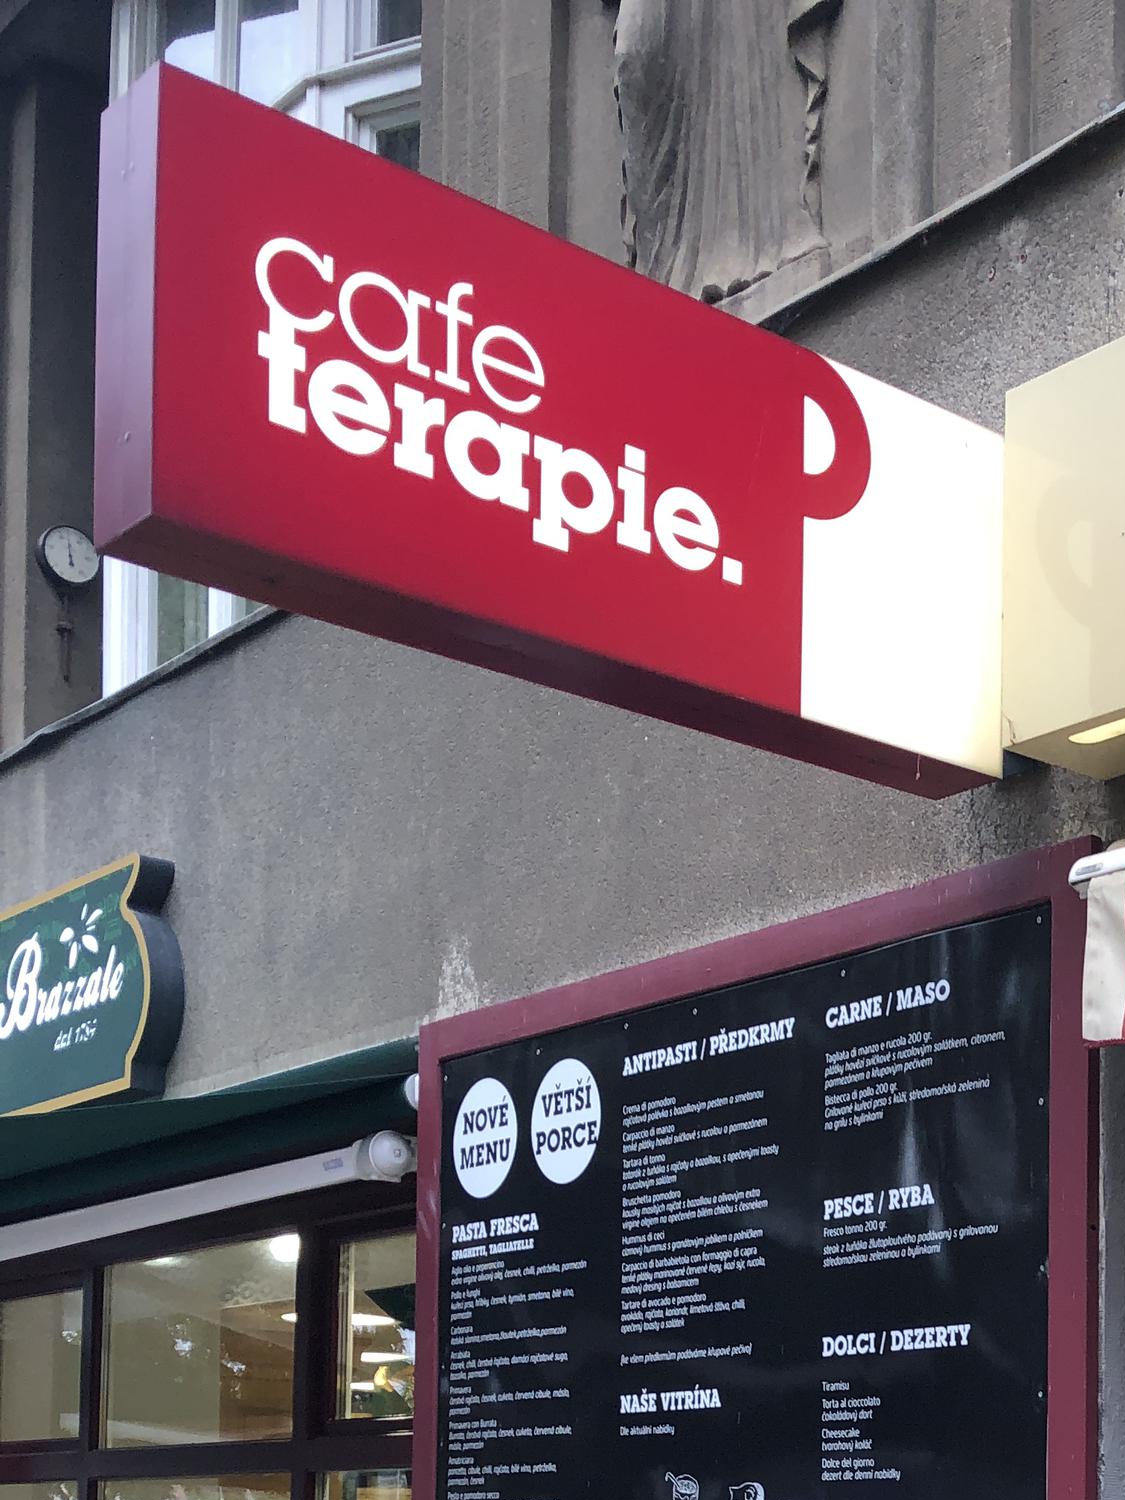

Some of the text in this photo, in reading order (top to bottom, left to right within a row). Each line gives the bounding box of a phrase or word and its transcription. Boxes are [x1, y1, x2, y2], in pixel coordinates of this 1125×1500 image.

[255, 237, 545, 413] cafe
[825, 995, 882, 1028] CARNE
[896, 979, 950, 1011] MASO
[622, 1041, 697, 1076] ANTIPASTI
[709, 1017, 796, 1056] PŘEDKRMY
[908, 1031, 922, 1045] 200
[541, 1076, 591, 1118] VĚTŠÍ
[463, 1095, 508, 1135] NOVÉ
[460, 1137, 511, 1170] MENU
[535, 1120, 599, 1155] PORCE
[823, 1193, 874, 1220] PESCE
[888, 1184, 935, 1210] RYBA
[452, 1213, 539, 1243] PASTA FRESCA
[822, 1332, 876, 1357] DOLCI
[890, 1323, 971, 1351] DEZERTY
[620, 1384, 722, 1414] NAŠE VITRÍNA
